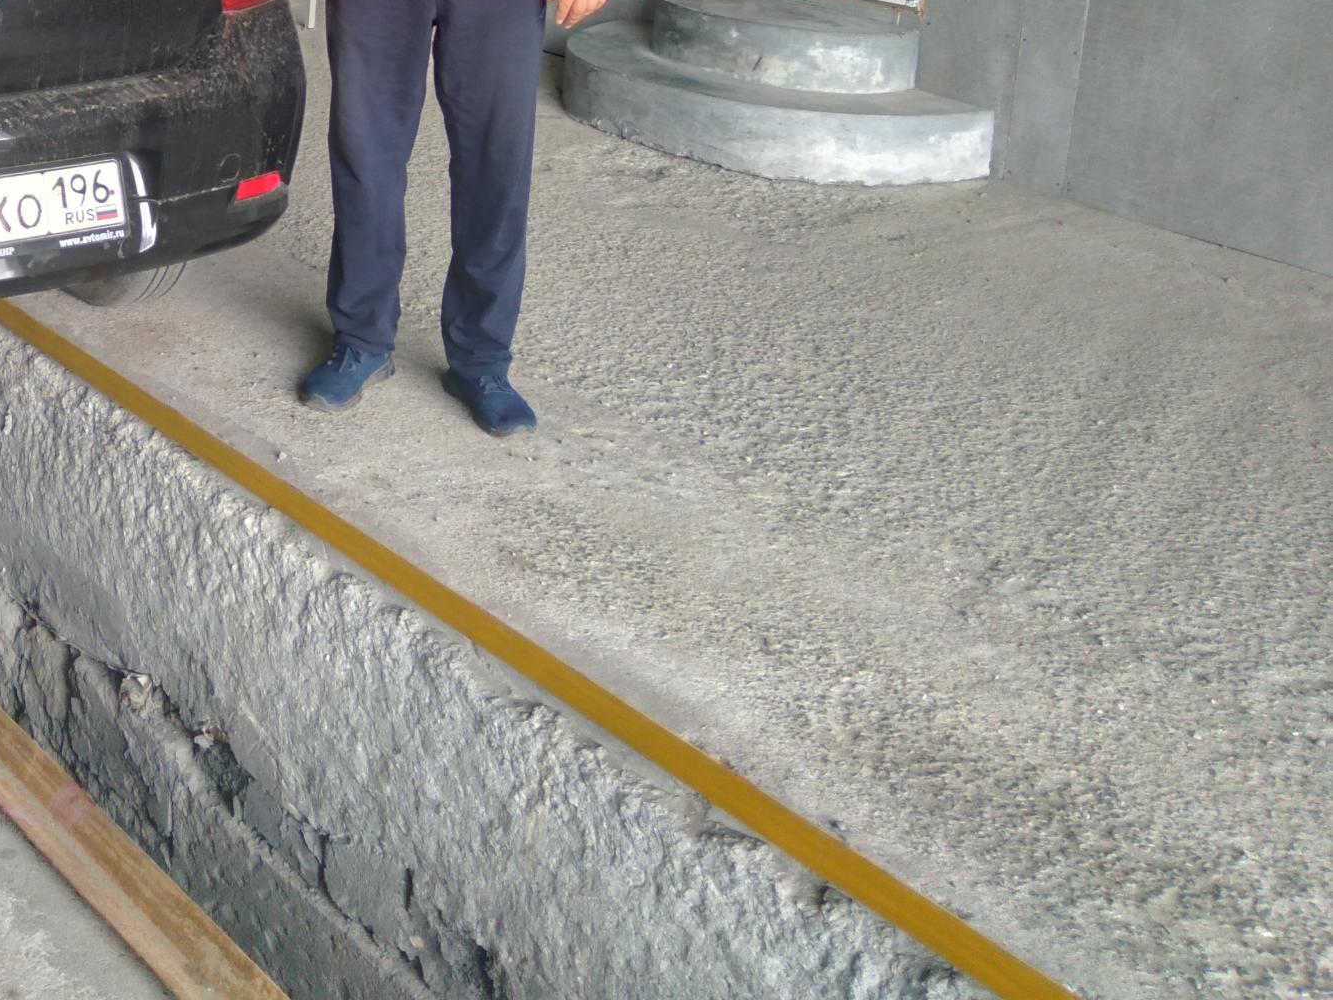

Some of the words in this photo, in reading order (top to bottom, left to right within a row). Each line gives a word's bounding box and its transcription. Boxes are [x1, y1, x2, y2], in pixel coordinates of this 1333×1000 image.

[51, 169, 110, 209] 196
[65, 209, 96, 225] RUS
[59, 229, 125, 249] www.avtomir.ru
